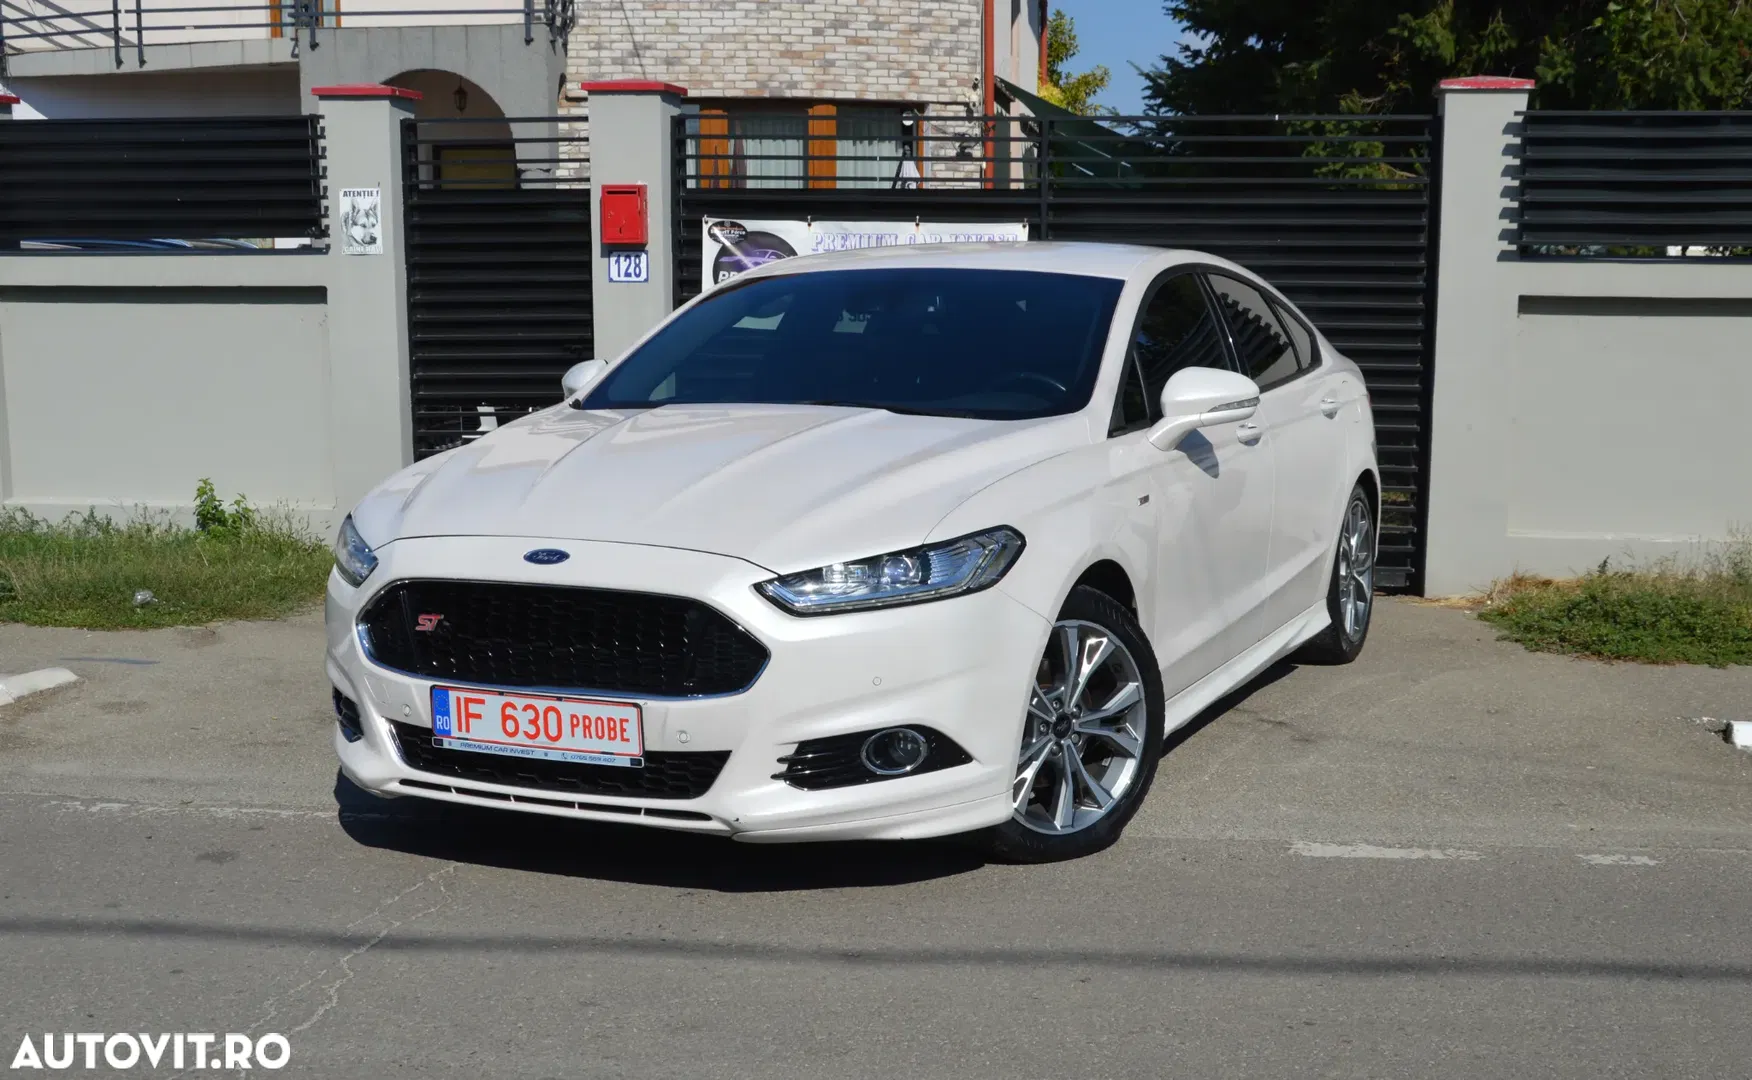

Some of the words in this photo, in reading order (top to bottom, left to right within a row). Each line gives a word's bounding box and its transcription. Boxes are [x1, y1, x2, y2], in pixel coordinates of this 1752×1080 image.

[614, 254, 642, 278] 128
[415, 613, 443, 632] ST
[436, 714, 450, 731] RO
[456, 695, 486, 734] IF
[501, 700, 563, 743] 630
[569, 713, 631, 743] PROBE
[460, 742, 493, 751] PREMIUM
[509, 748, 535, 756] INVEST
